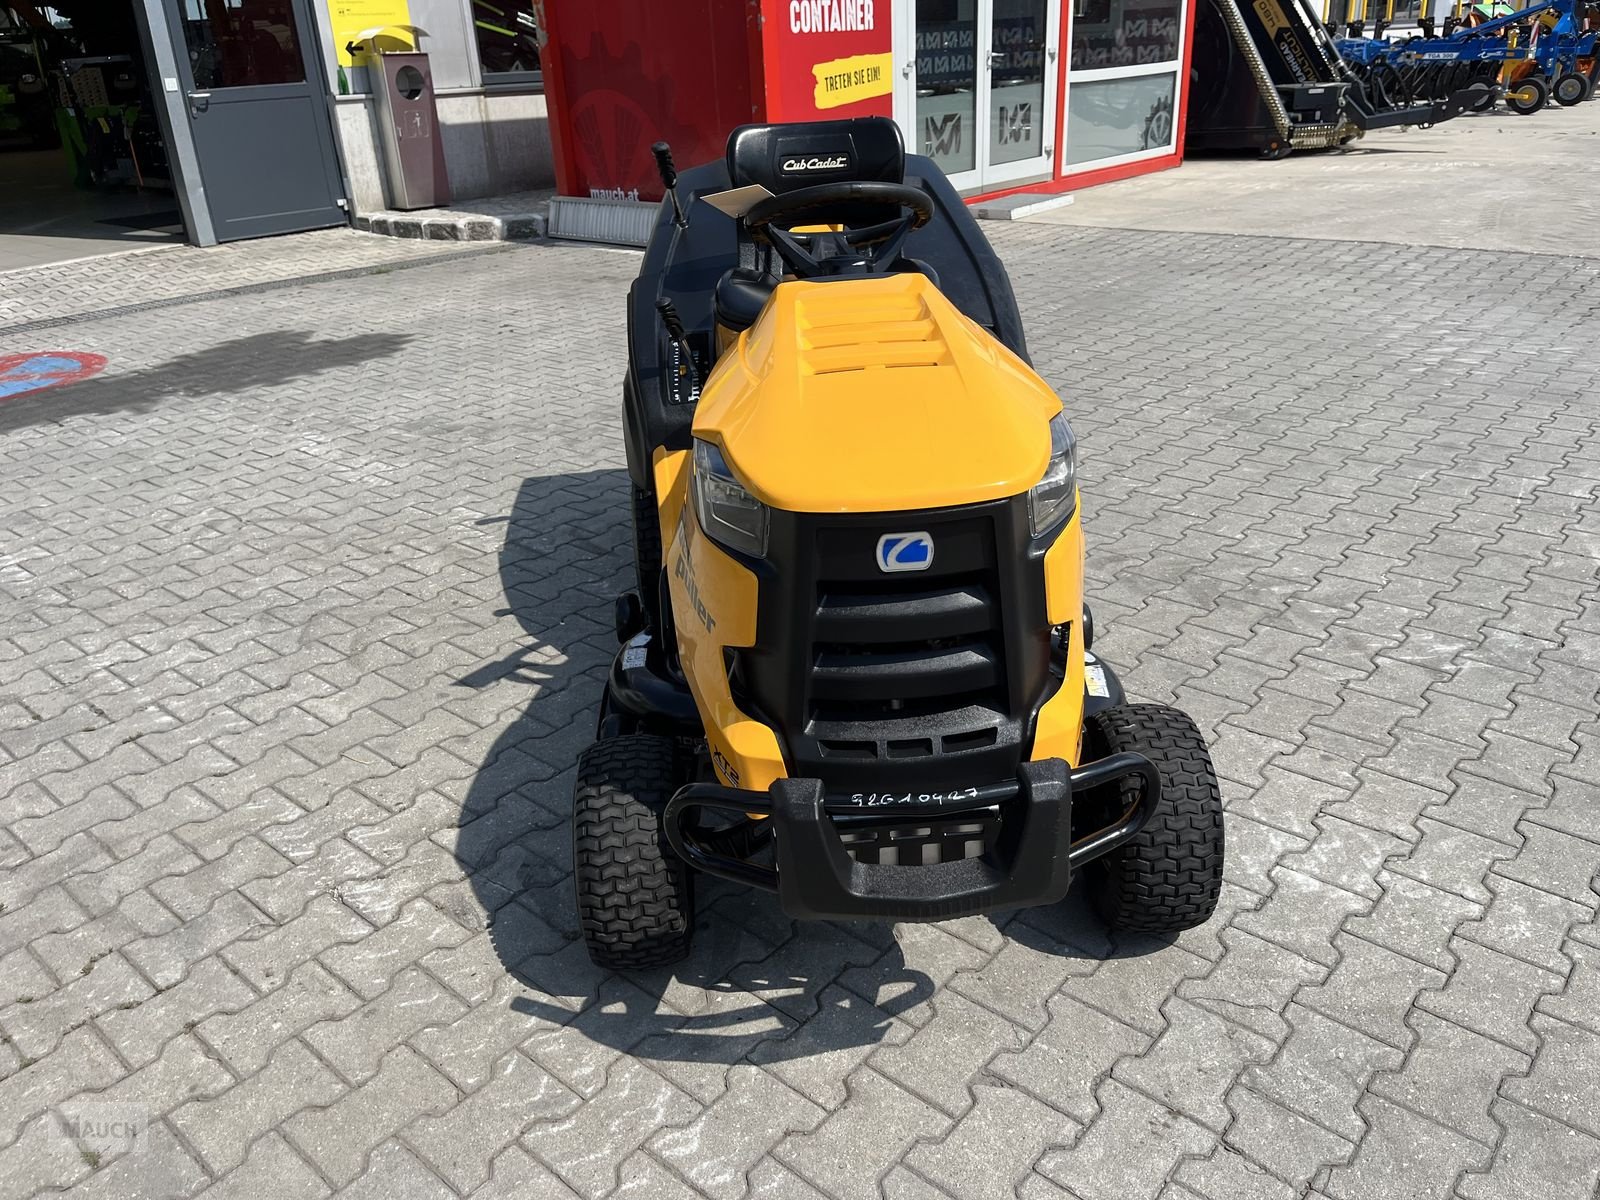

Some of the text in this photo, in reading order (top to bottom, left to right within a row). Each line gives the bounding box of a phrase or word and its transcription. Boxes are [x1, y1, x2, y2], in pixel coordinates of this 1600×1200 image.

[790, 0, 874, 33] CONTAINER
[1280, 41, 1306, 82] EARHEAD
[824, 66, 881, 92] TRETEN SIE EIN!
[783, 159, 807, 171] Cub
[590, 187, 640, 202] mauch.at
